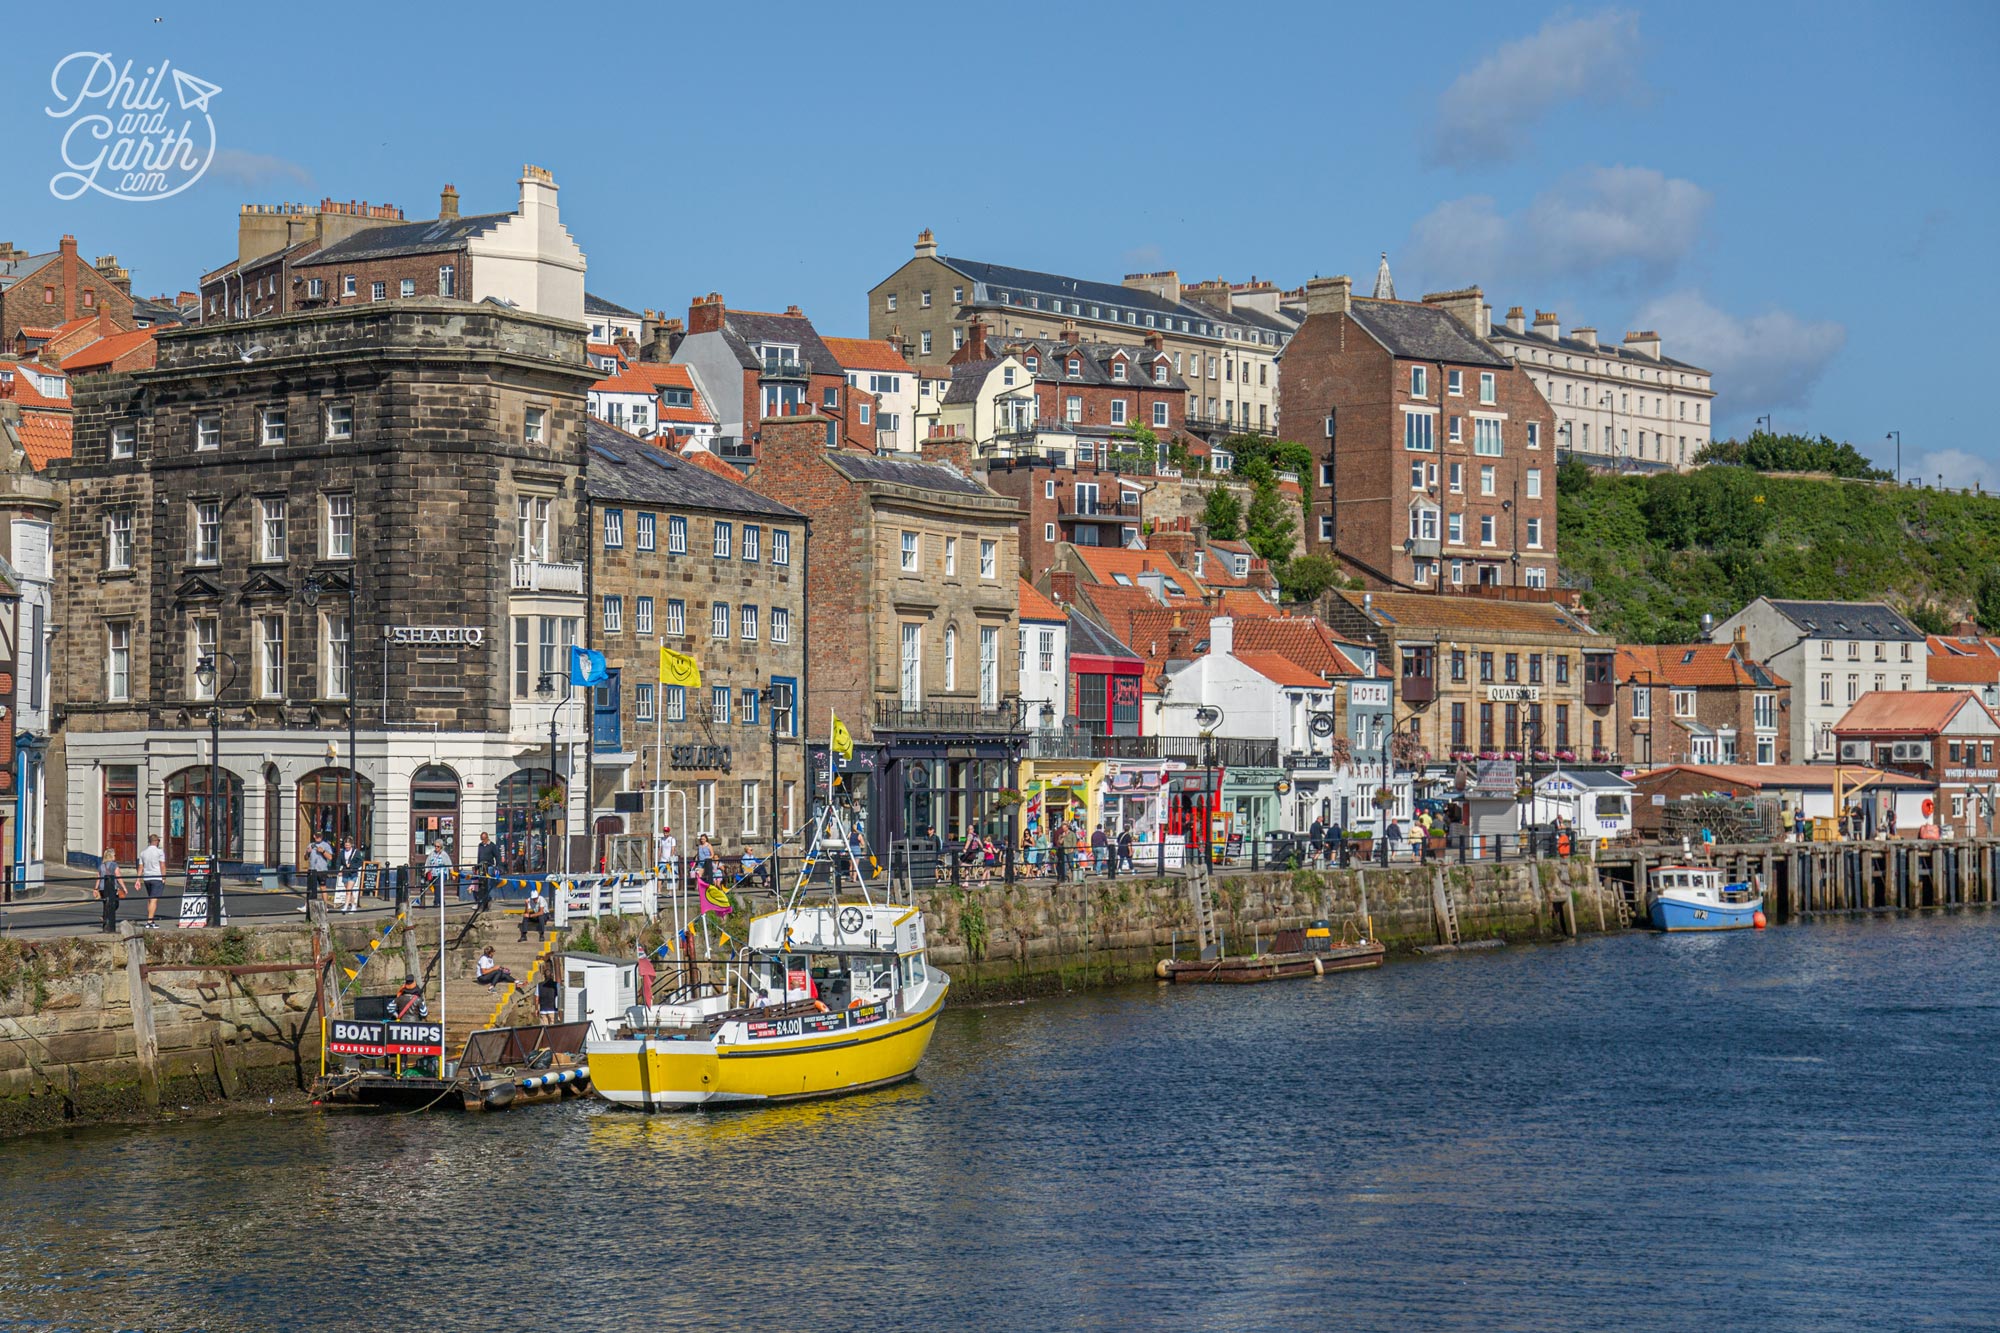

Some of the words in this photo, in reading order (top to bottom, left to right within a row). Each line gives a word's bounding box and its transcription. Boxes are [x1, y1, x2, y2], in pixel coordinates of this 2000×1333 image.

[394, 627, 482, 646] SHAFIQ
[1353, 687, 1387, 701] HOTEL
[1491, 688, 1537, 702] QUAYSDE
[671, 744, 733, 772] SHAFIQ
[1348, 765, 1390, 779] MARINE
[1945, 769, 1965, 778] WHITBY
[1965, 769, 1977, 778] FISH
[1977, 769, 1998, 778] MARKET
[1547, 781, 1573, 790] TEAS
[1601, 820, 1617, 829] TEAS
[182, 902, 207, 916] £4.00
[860, 1007, 874, 1017] YELLOW
[335, 1025, 381, 1042] BOAT
[389, 1026, 441, 1042] TRIPS
[776, 1019, 799, 1036] £4.00
[333, 1044, 383, 1053] BOARDING
[399, 1046, 430, 1054] POINT
